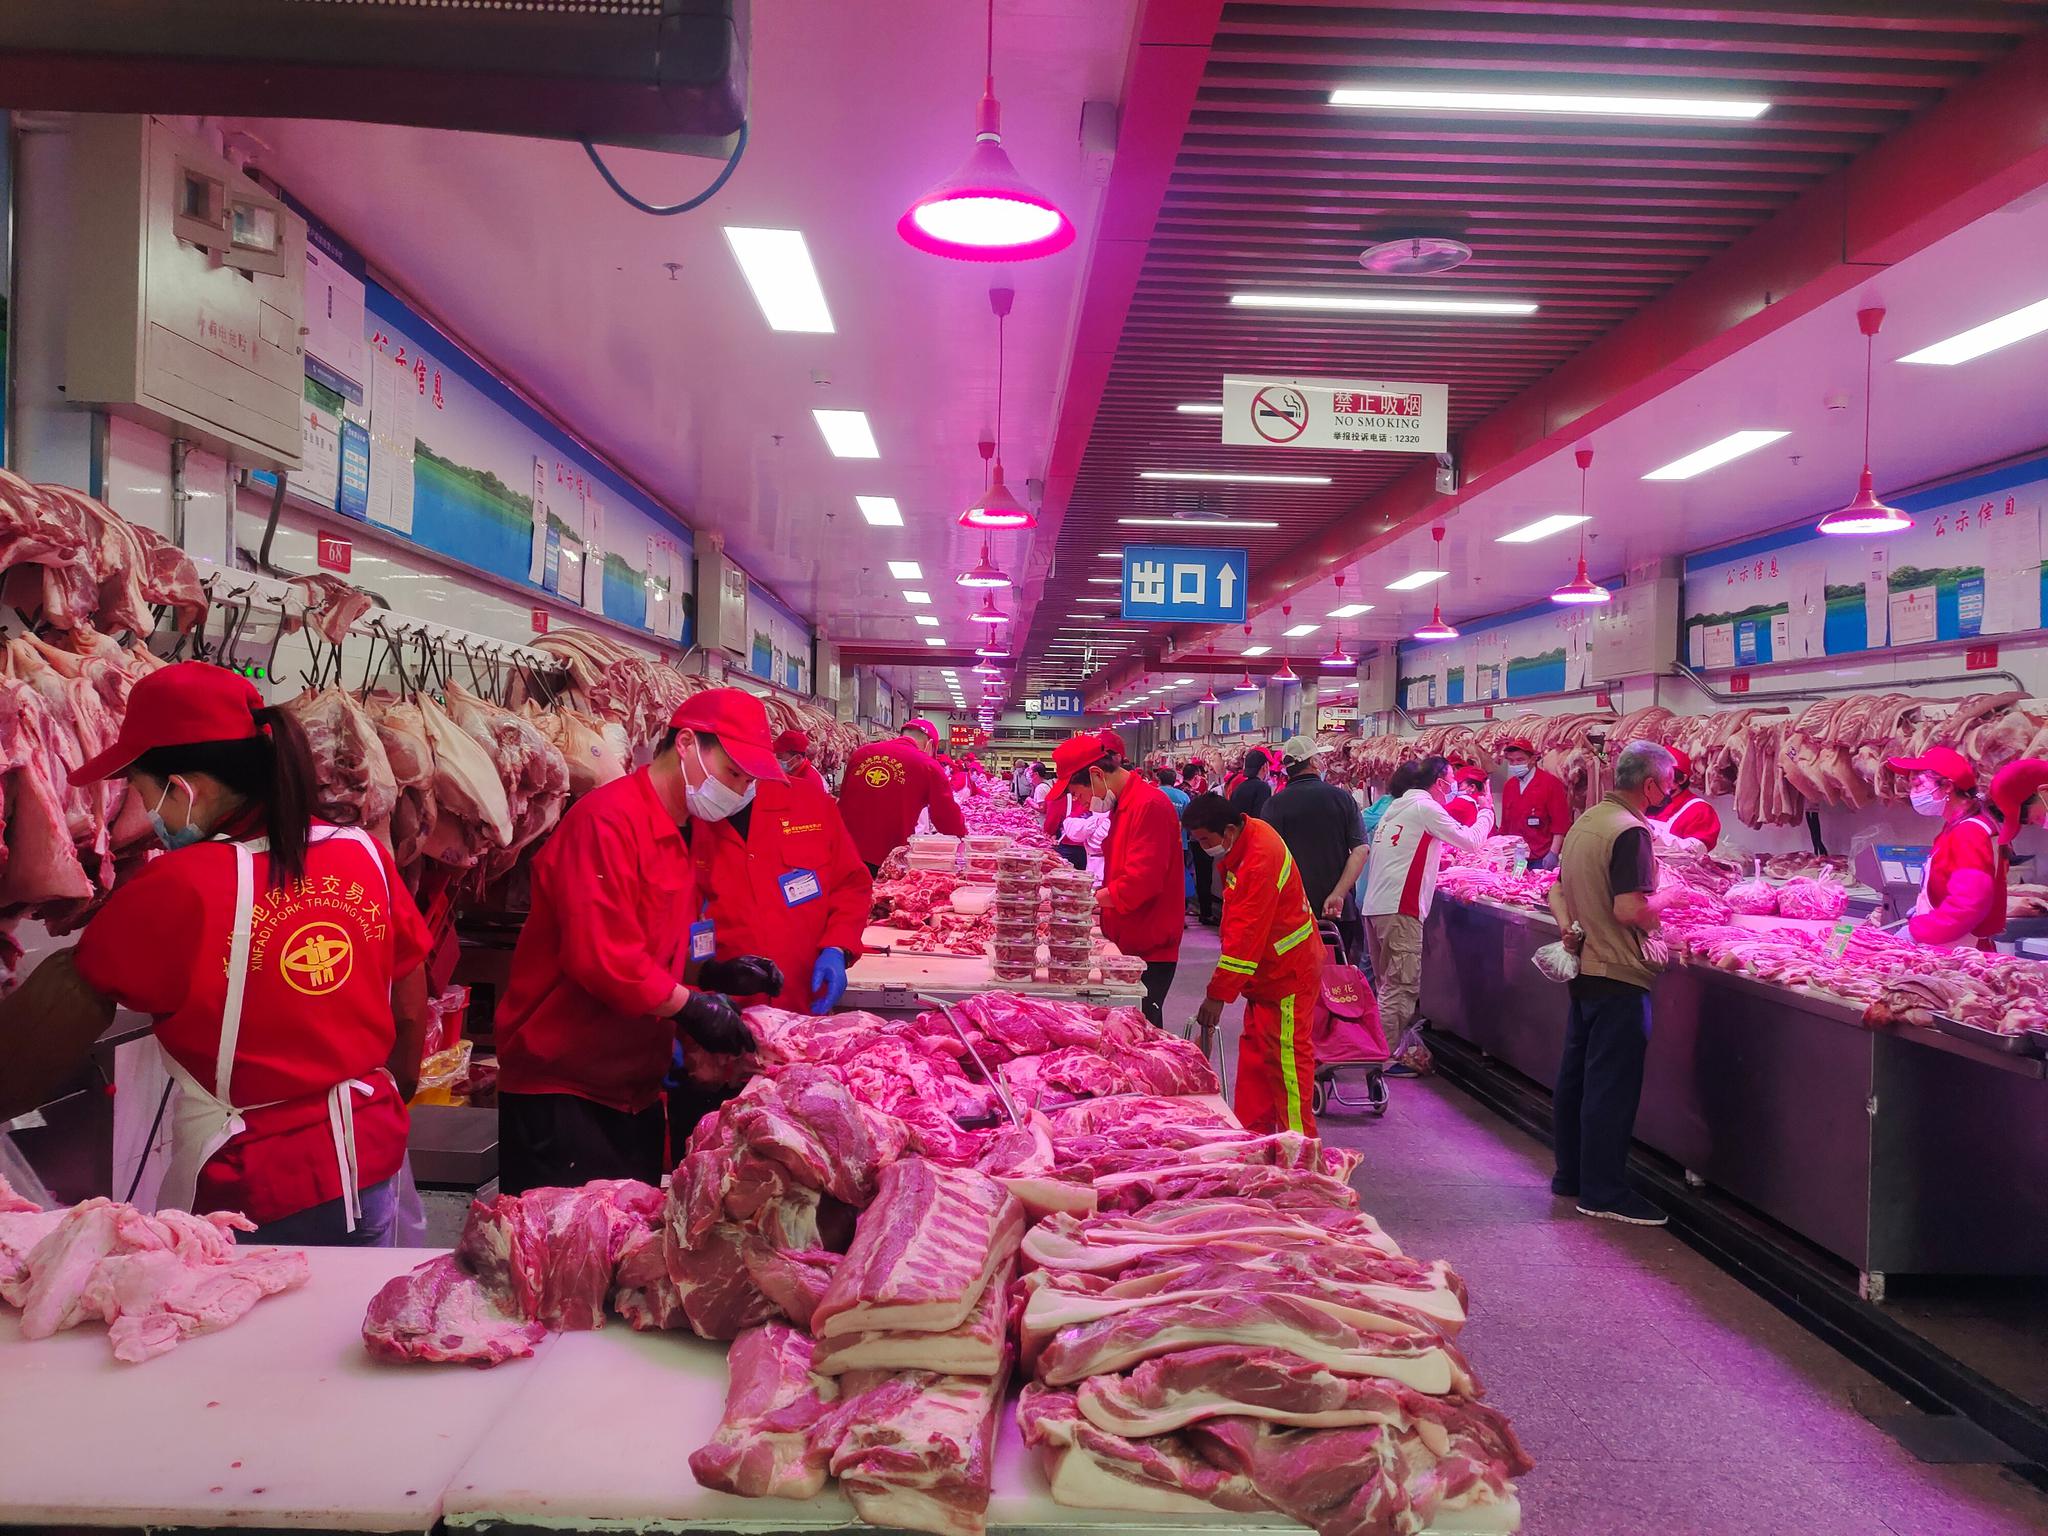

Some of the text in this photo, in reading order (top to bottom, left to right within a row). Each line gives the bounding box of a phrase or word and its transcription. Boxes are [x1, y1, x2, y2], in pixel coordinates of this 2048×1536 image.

[1334, 392, 1422, 416] 禁止吸烟
[1335, 416, 1420, 429] NO SMOKING
[328, 542, 342, 563] 68
[1726, 553, 1780, 585] 公示信息
[1131, 560, 1206, 604] 出口
[1043, 693, 1070, 711] 出口
[251, 897, 376, 972] XINFADI PORK TRADING HALL
